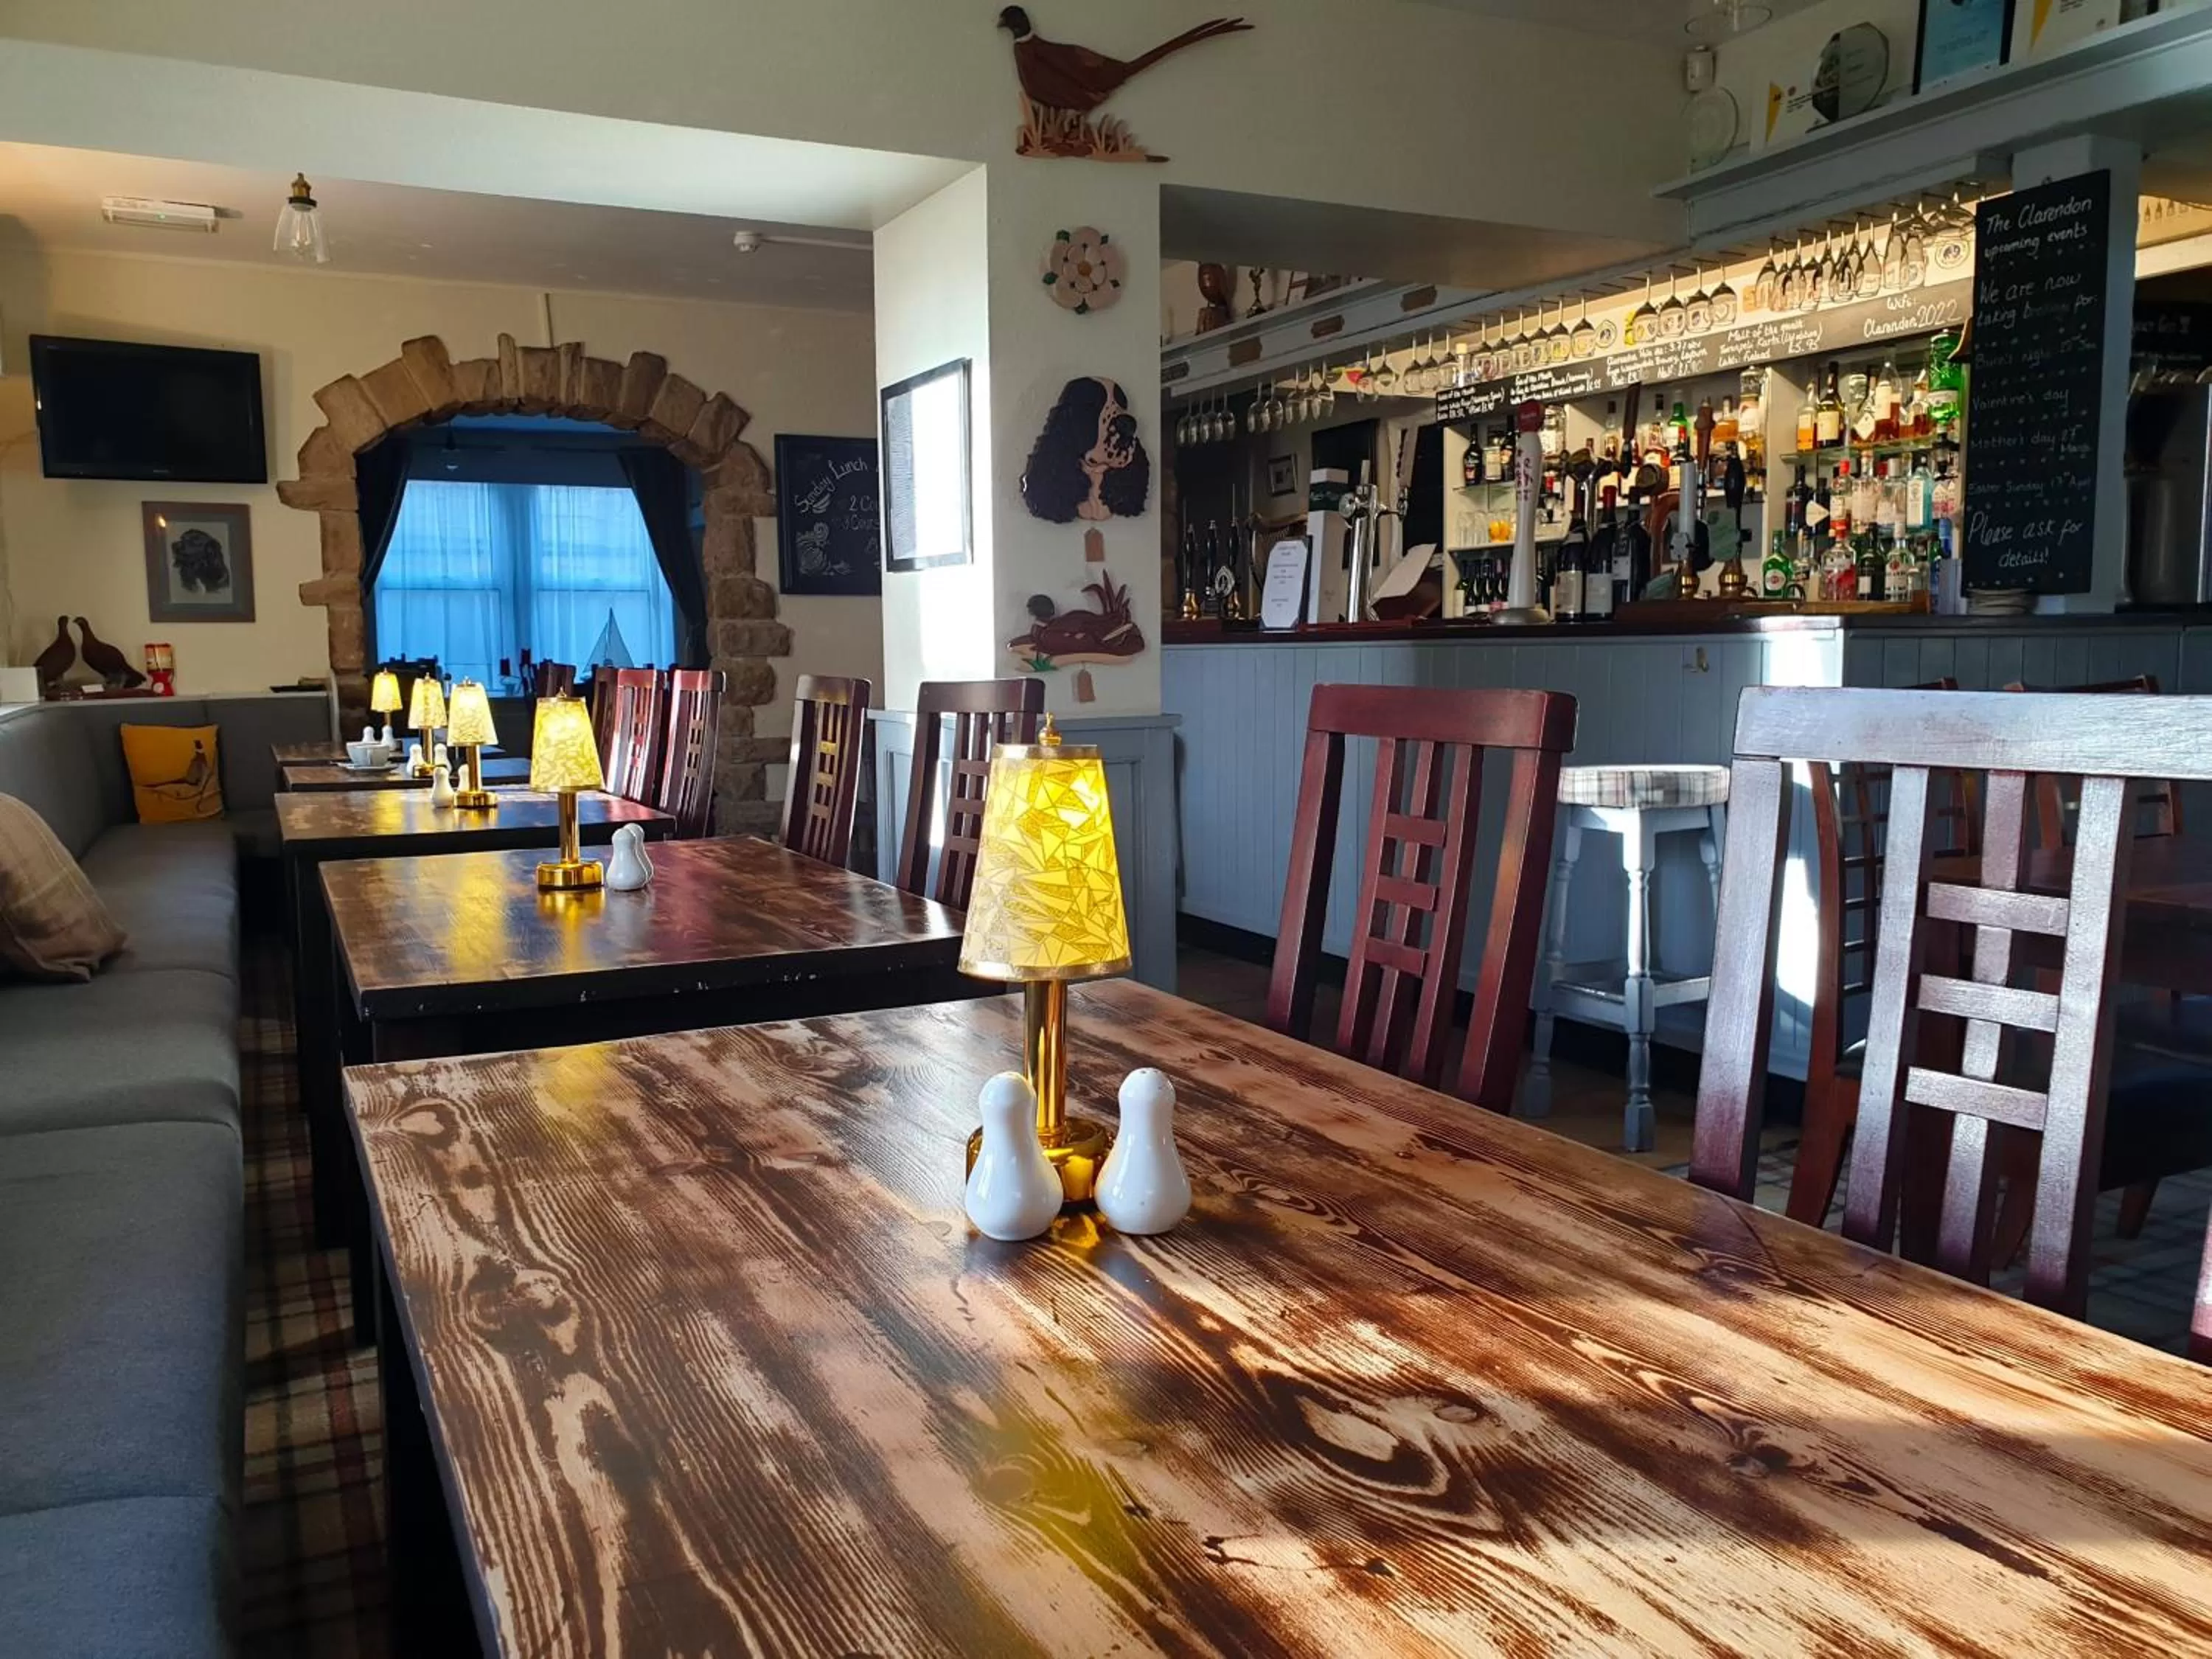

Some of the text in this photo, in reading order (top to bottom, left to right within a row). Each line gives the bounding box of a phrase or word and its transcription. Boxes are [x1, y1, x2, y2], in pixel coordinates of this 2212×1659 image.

[1986, 195, 2092, 236] The Clarendon
[1983, 223, 2087, 259] upcoming events
[1980, 273, 2081, 304] We are now
[2042, 389, 2069, 408] day
[2030, 429, 2056, 452] day
[794, 457, 868, 514] Sunday Lunch
[2005, 479, 2045, 498] Sunday
[1968, 510, 2013, 546] Please
[2023, 518, 2056, 539] ask
[2058, 518, 2084, 546] for
[1998, 547, 2049, 568] details!
